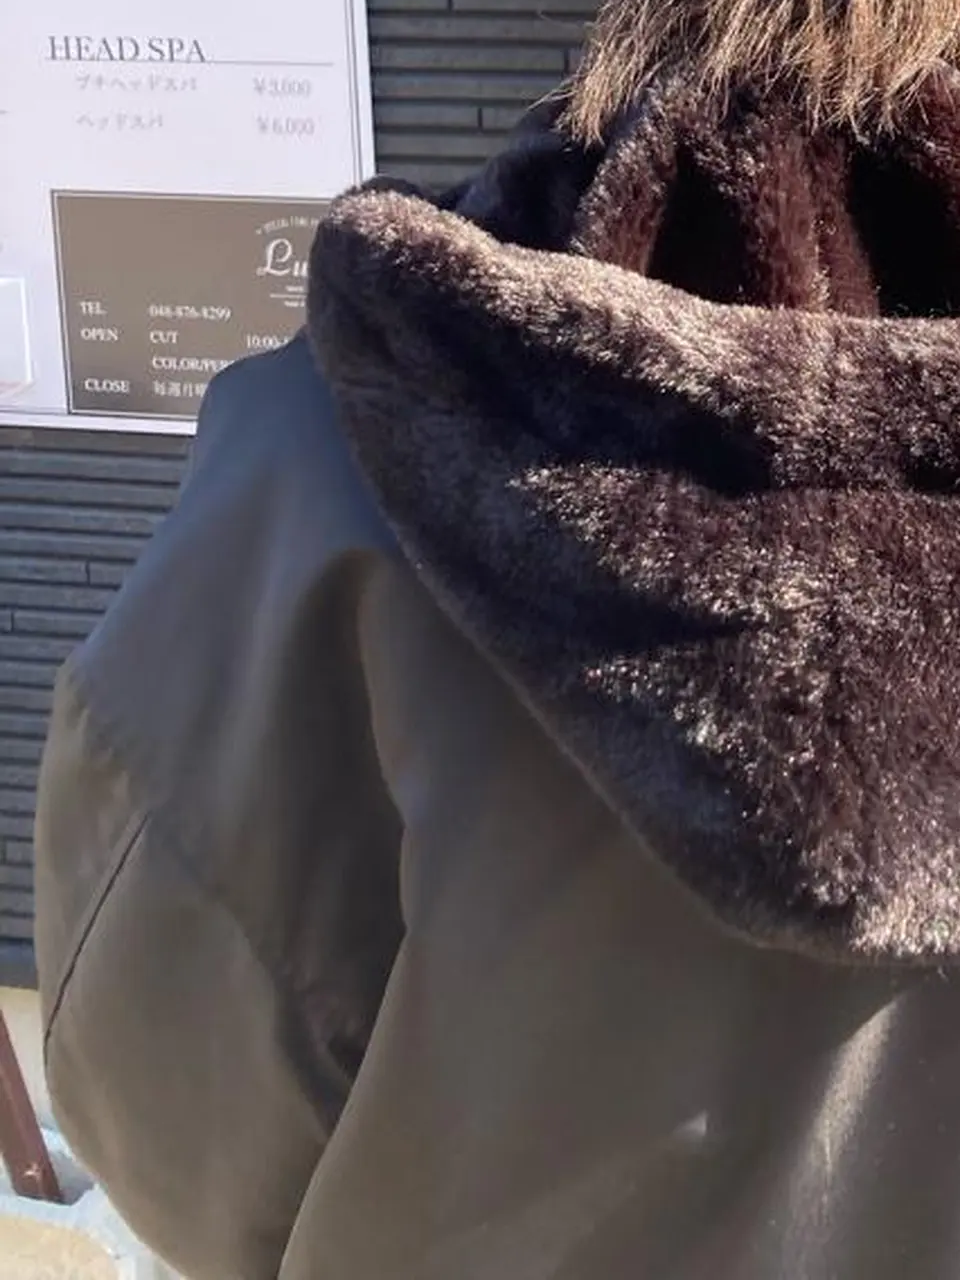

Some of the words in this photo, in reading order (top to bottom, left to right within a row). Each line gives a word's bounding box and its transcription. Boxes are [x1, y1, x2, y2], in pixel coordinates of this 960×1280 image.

[48, 35, 141, 62] HEAD
[147, 37, 207, 63] SPA
[256, 238, 308, 276] Lu
[80, 326, 119, 342] OPEN
[149, 329, 178, 345] CUT
[84, 378, 131, 394] CLOSE
